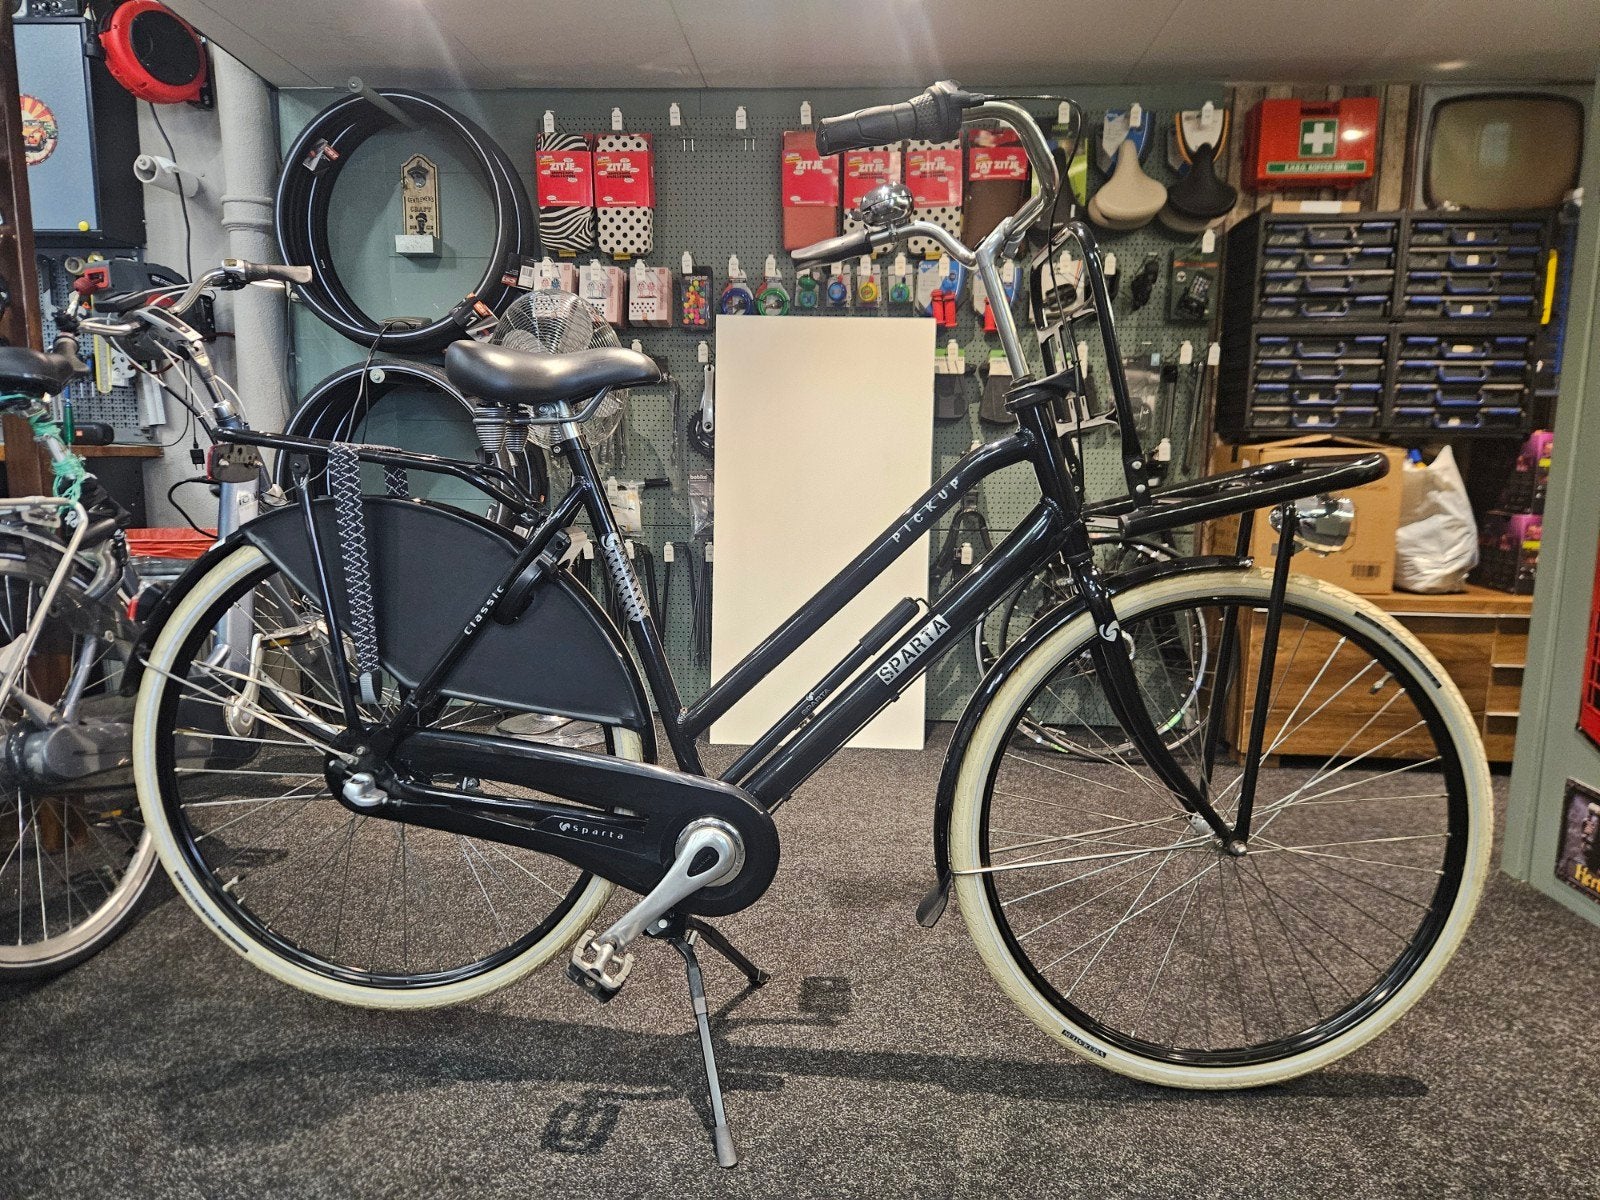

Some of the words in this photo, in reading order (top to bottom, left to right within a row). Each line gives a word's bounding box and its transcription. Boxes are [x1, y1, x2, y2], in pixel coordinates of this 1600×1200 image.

[892, 476, 959, 543] PICKUP
[463, 585, 505, 636] Classic
[879, 618, 949, 684] SPARTA
[572, 824, 624, 841] sparta
